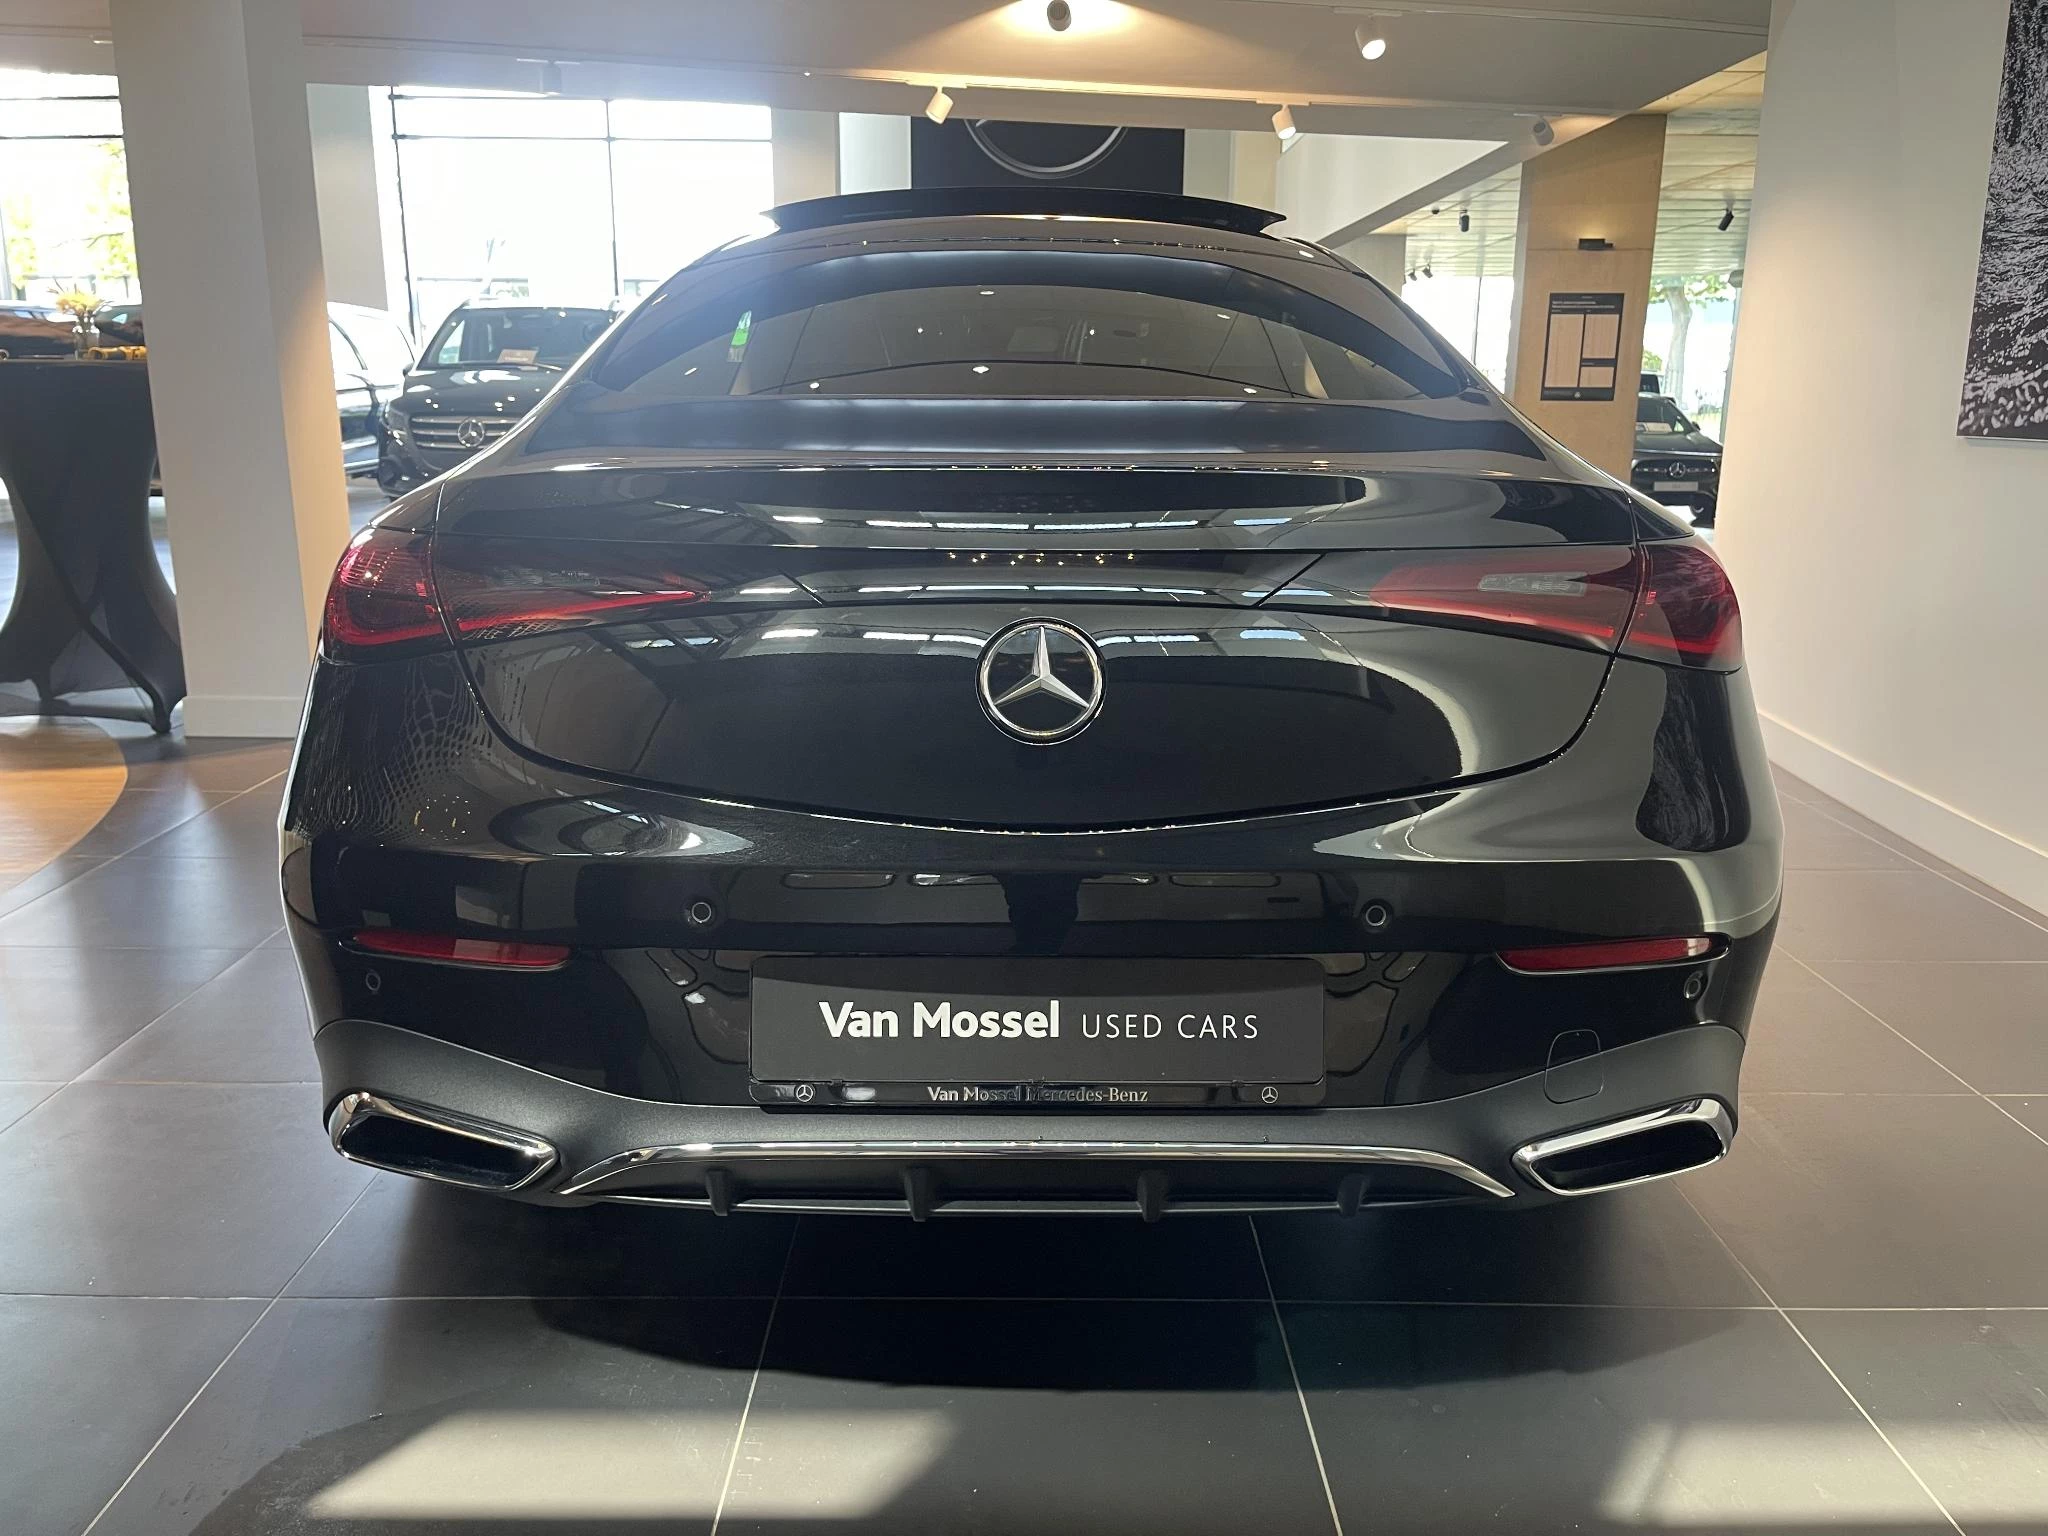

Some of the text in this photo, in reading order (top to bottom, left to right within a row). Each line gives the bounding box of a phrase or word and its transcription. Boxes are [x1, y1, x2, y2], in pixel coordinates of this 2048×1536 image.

[819, 1000, 1258, 1039] Van Mossel USED CARS
[927, 1086, 1149, 1102] Van Mossel Mercedes-Benz
